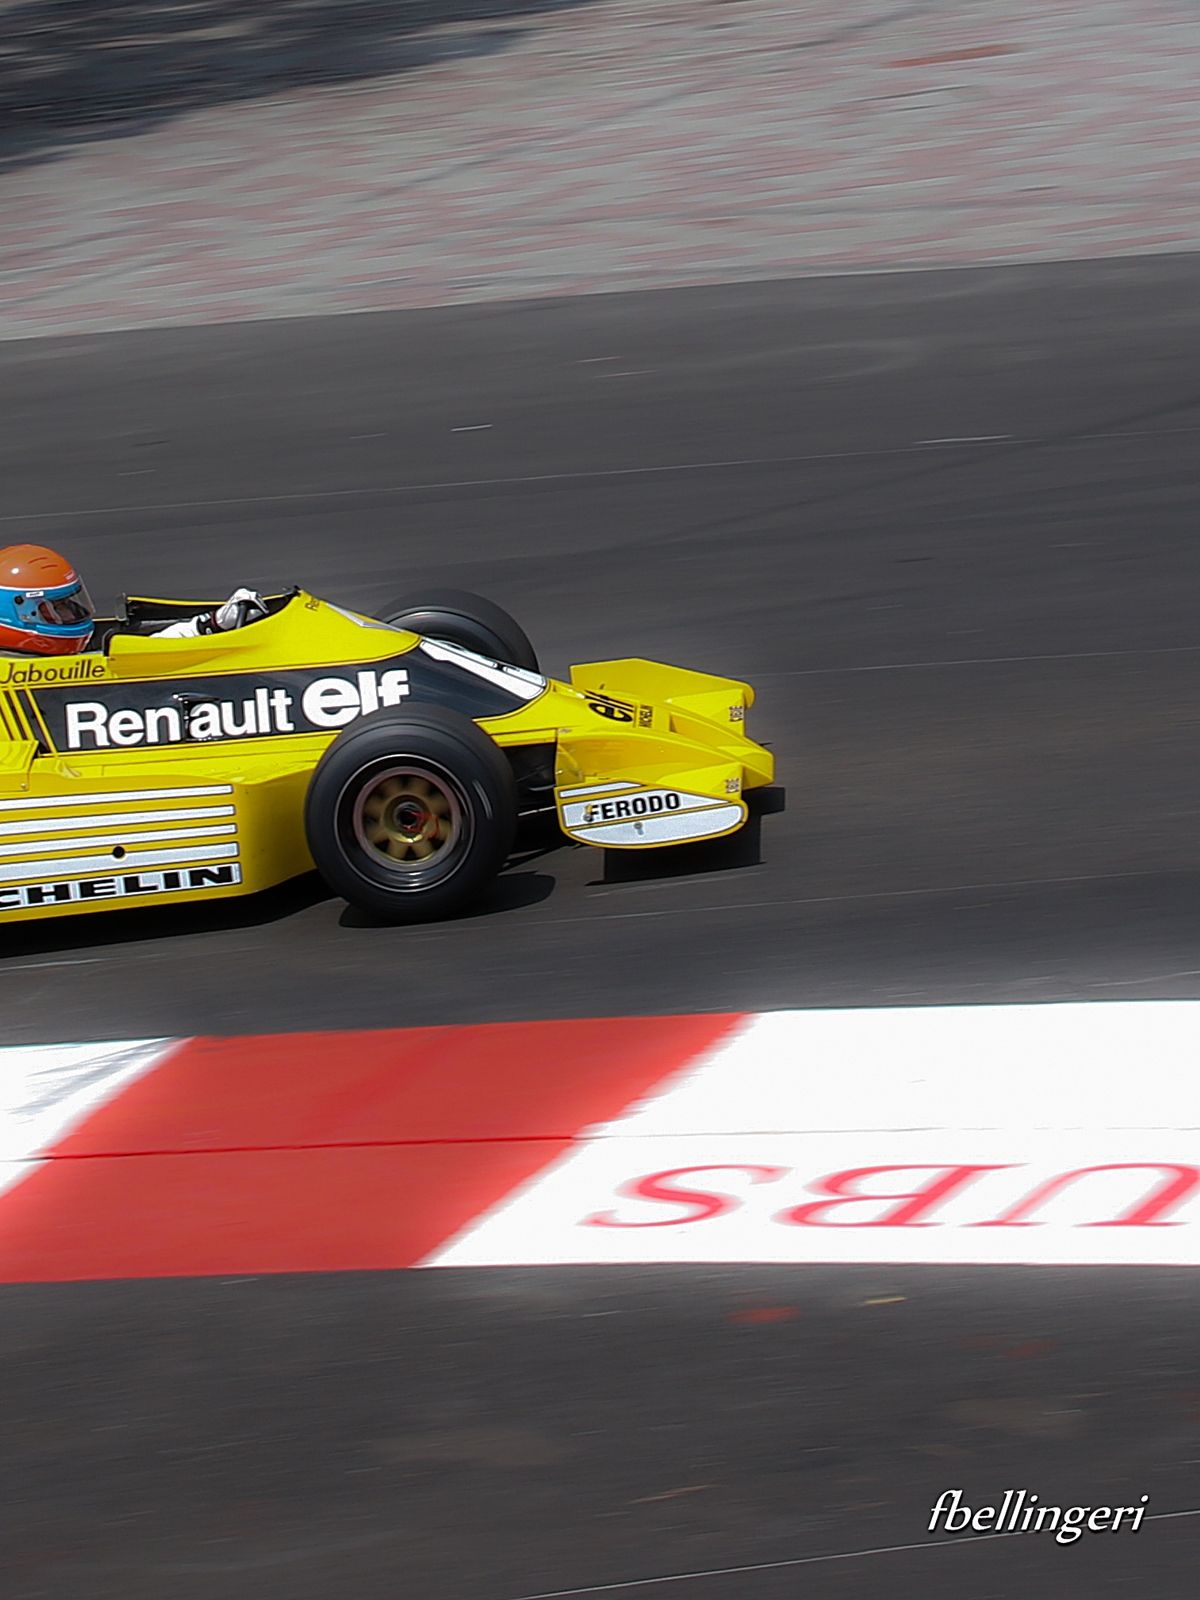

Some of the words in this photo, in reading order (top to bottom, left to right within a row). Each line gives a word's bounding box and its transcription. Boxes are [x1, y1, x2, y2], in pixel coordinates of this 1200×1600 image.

[1, 660, 106, 684] Jabouille
[65, 688, 294, 749] Renault
[302, 669, 410, 727] elf
[575, 1163, 1200, 1228] UBS
